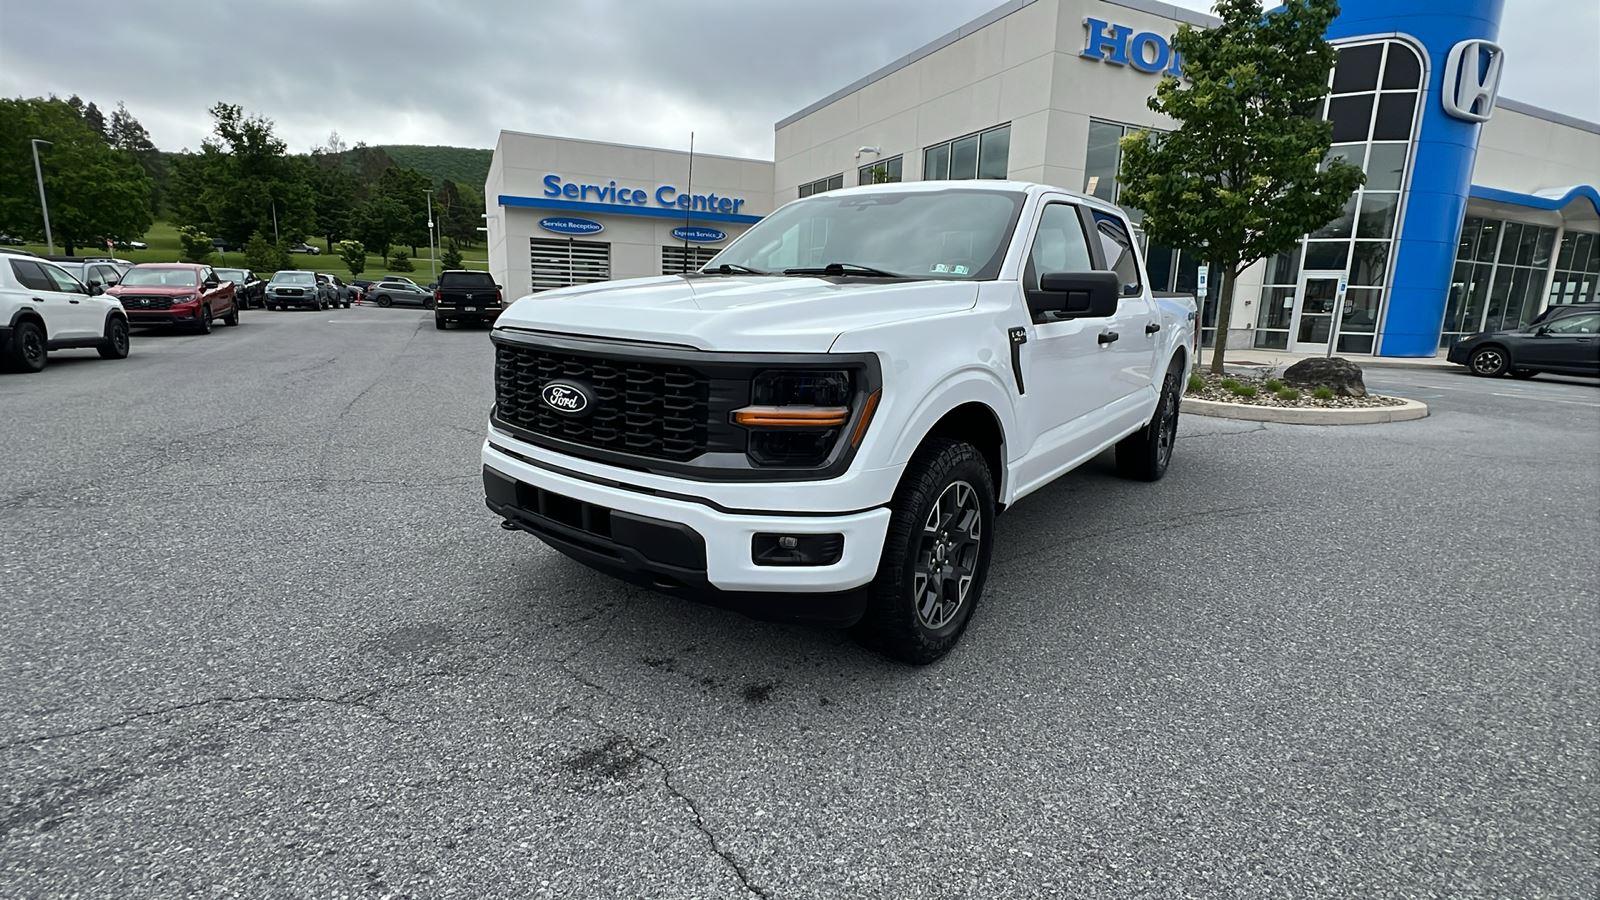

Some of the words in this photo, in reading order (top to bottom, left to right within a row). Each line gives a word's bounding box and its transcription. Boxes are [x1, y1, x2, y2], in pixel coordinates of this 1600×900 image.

[543, 174, 648, 205] Service
[655, 185, 745, 214] Center
[543, 220, 567, 228] Service
[568, 222, 600, 230] Reception
[550, 387, 578, 408] Ford
